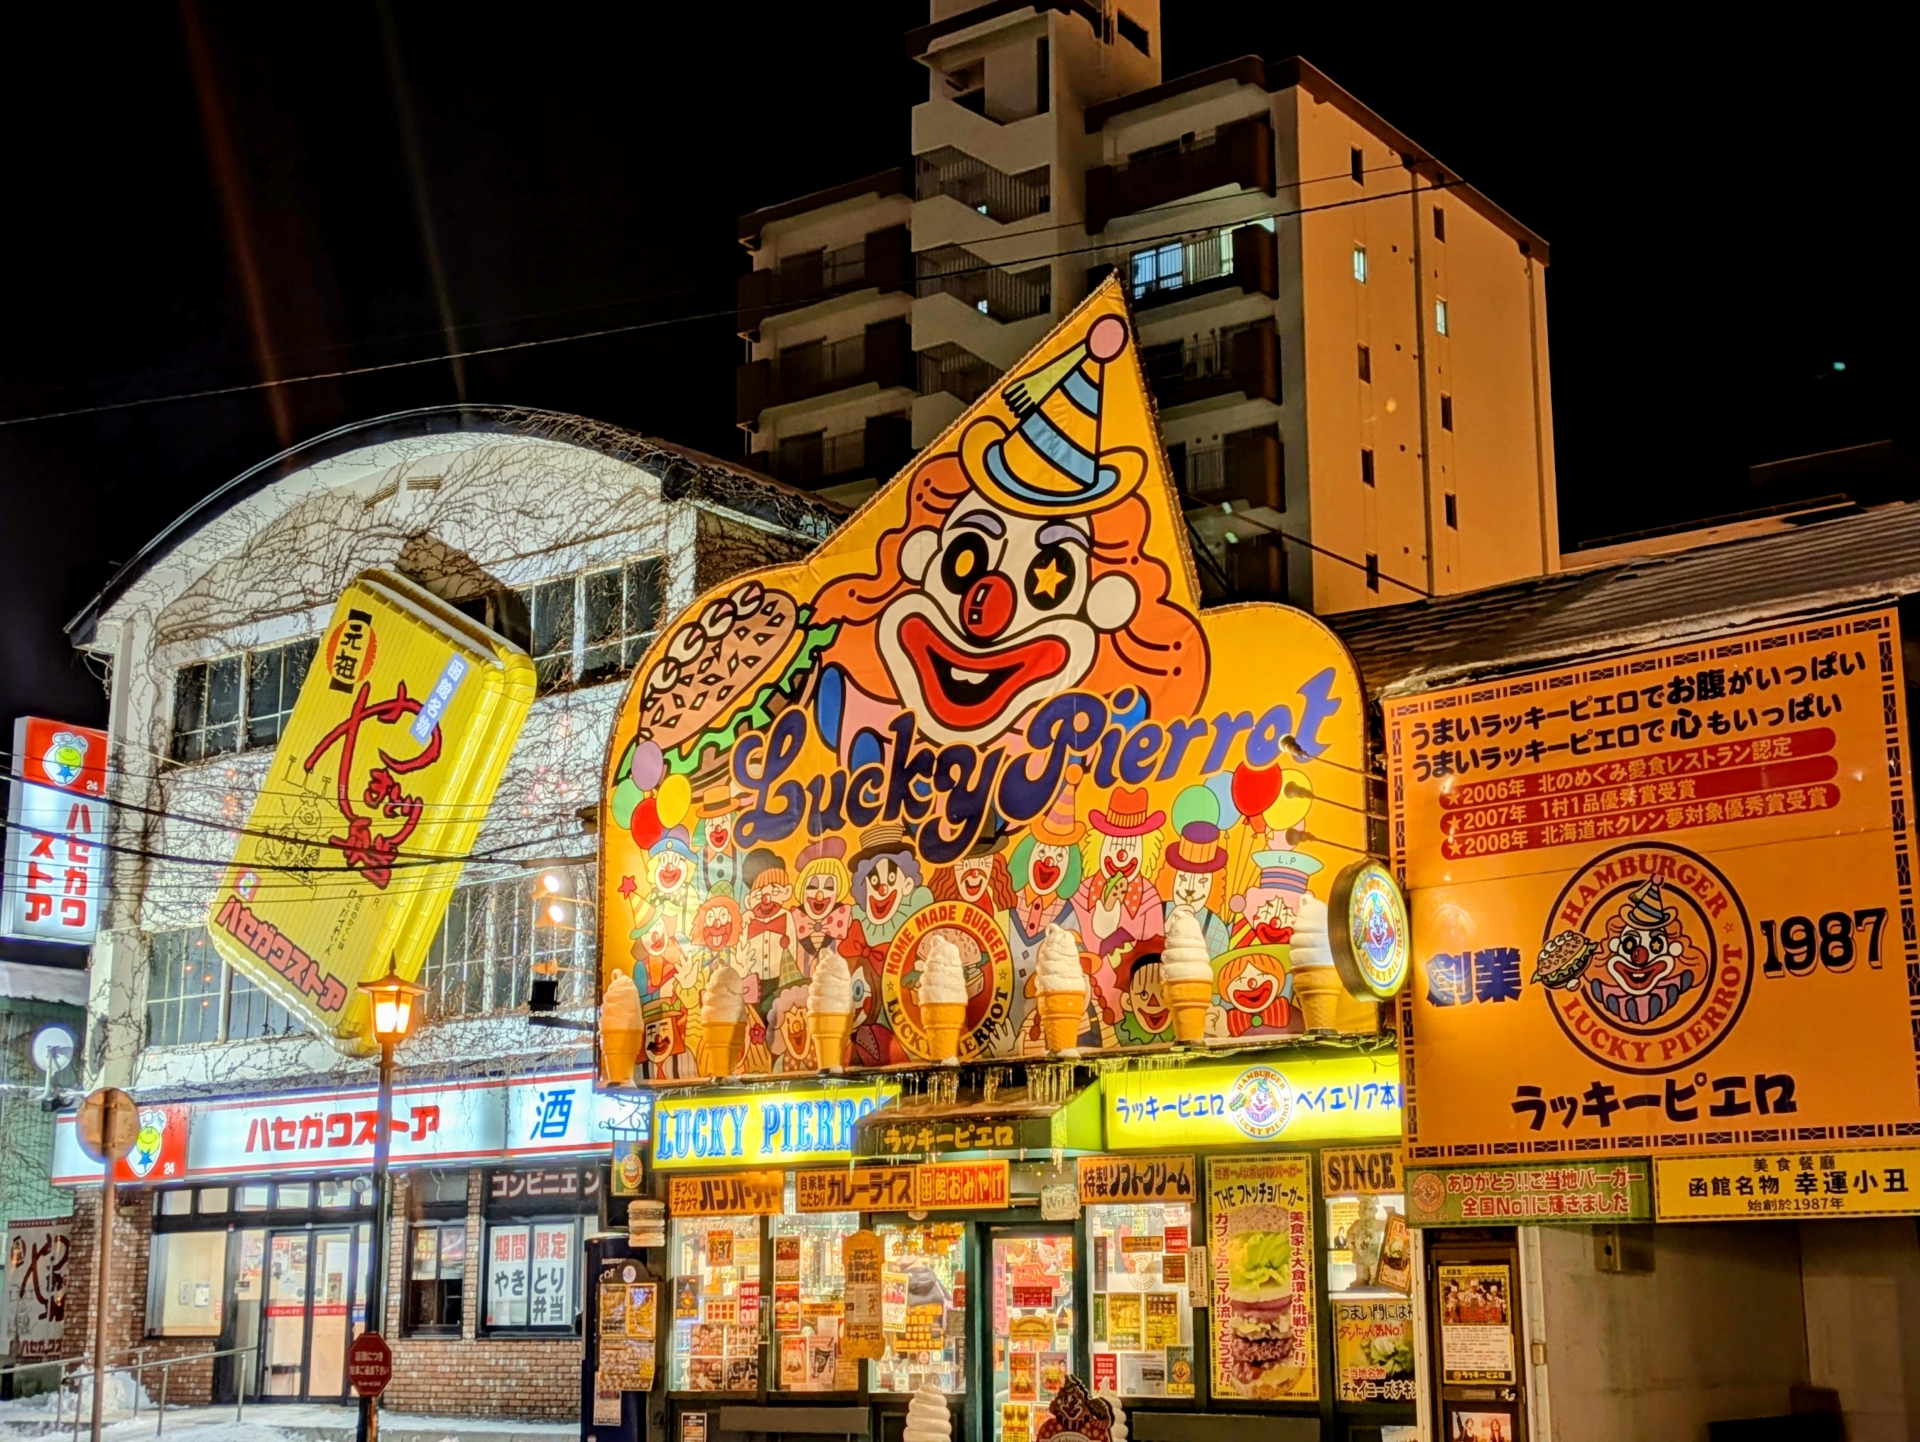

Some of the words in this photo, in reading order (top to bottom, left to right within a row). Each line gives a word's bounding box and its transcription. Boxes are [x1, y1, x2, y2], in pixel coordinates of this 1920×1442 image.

[334, 624, 363, 681] 元祖
[1411, 649, 1867, 750] うまいラッキーピエロでお腹がいっぱい
[1412, 693, 1843, 782] うまいラッキーピエロで心もいっぱい
[732, 707, 1007, 864] Lucky
[997, 667, 1342, 822] Pierrot
[1538, 736, 1793, 793] 北のめぐみ愛食レストラン認定
[86, 780, 98, 792] 24
[60, 803, 92, 928] ハセガワ
[1563, 853, 1728, 928] HAMBURGER
[214, 895, 347, 1012] ハセガワストア
[885, 926, 916, 976] HOME
[914, 904, 957, 933] MADE
[961, 906, 1008, 965] BURGER
[1760, 907, 1887, 979] 1987
[1426, 947, 1523, 1008] 創業
[1561, 997, 1650, 1063] LUCKY
[1662, 944, 1744, 1062] PIERROT
[1236, 1069, 1287, 1092] HAMBURGER
[1296, 1082, 1403, 1113] ベイエリア本
[529, 1088, 576, 1141] 酒
[1116, 1094, 1225, 1124] ラッキーピエロ
[1237, 1112, 1264, 1136] LUCKY
[1265, 1097, 1291, 1136] PIERROT
[1511, 1072, 1798, 1132] ラッキーピエロ
[245, 1103, 442, 1154] ハセガワストア
[655, 1105, 749, 1161] LUCKY
[883, 1123, 1014, 1153] ラッキーピエロ
[163, 1162, 175, 1175] 24
[800, 1175, 826, 1191] 自家製
[920, 1169, 1004, 1202] 函館おみやげ
[1328, 1152, 1395, 1192] SINCE
[1447, 1166, 1645, 1193] ありがとう!!ご当地バーガー
[1688, 1175, 1780, 1198] 函館名物
[1794, 1168, 1909, 1196] 幸運小丑
[673, 1198, 699, 1212] デカウマ
[674, 1181, 698, 1196] 手づくり
[827, 1170, 913, 1207] カレーライス
[1213, 1186, 1236, 1211] THE
[494, 1266, 565, 1298] やきとり
[532, 1295, 564, 1323] 弁当
